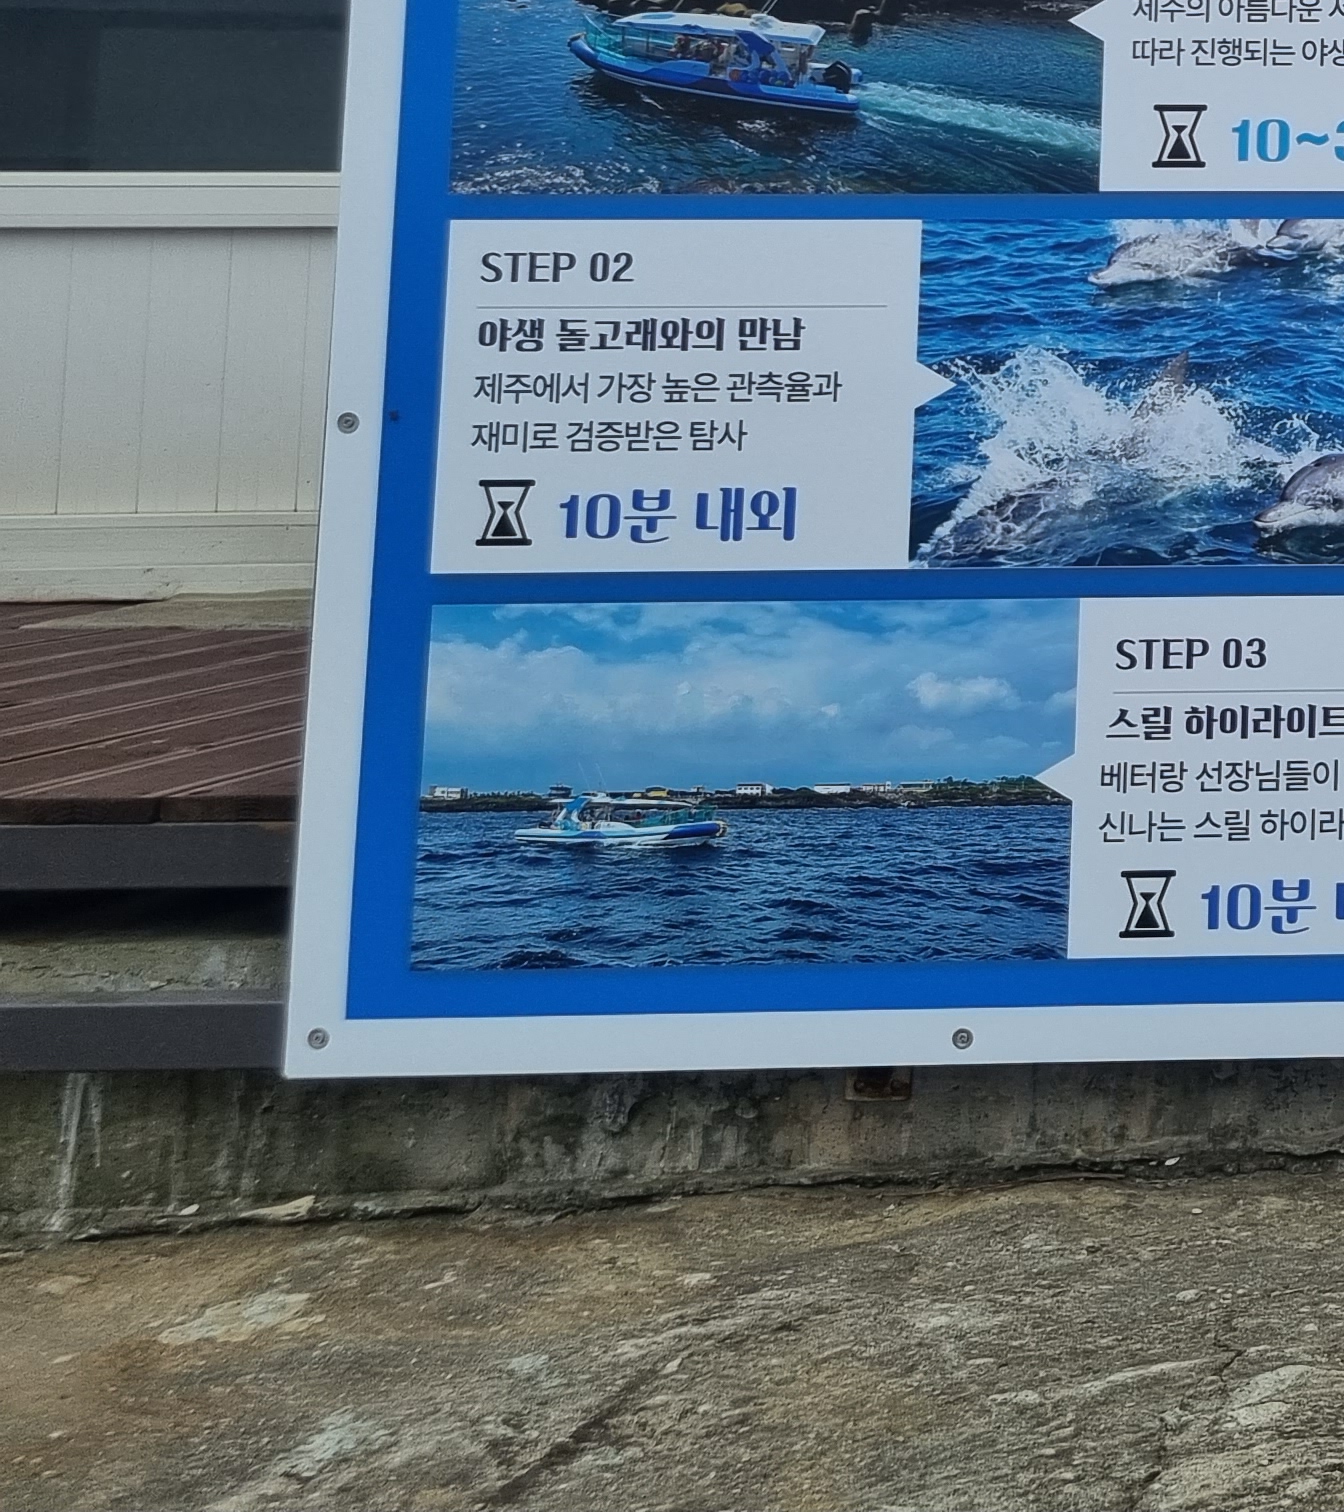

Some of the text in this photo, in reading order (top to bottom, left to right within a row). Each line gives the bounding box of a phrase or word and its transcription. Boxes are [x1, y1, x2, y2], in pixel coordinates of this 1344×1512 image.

[1131, 37, 1186, 68] 따라
[1190, 37, 1296, 68] 진행되는
[480, 251, 635, 284] STEP 02
[478, 317, 807, 353] 야생 돌고래와의 만남
[473, 371, 843, 404] 제주에서 가장 높은 관측율과
[471, 420, 749, 453] 재미로 검증받은 탐사
[558, 487, 797, 544] 10분 내외
[1115, 638, 1268, 670] STEP 03
[1106, 706, 1173, 740] 스릴
[1100, 761, 1187, 792] 베터랑
[1195, 759, 1340, 791] 선장님들이
[1099, 811, 1185, 843] 신나는
[1193, 810, 1250, 841] 스릴
[1201, 878, 1316, 934] 10분
